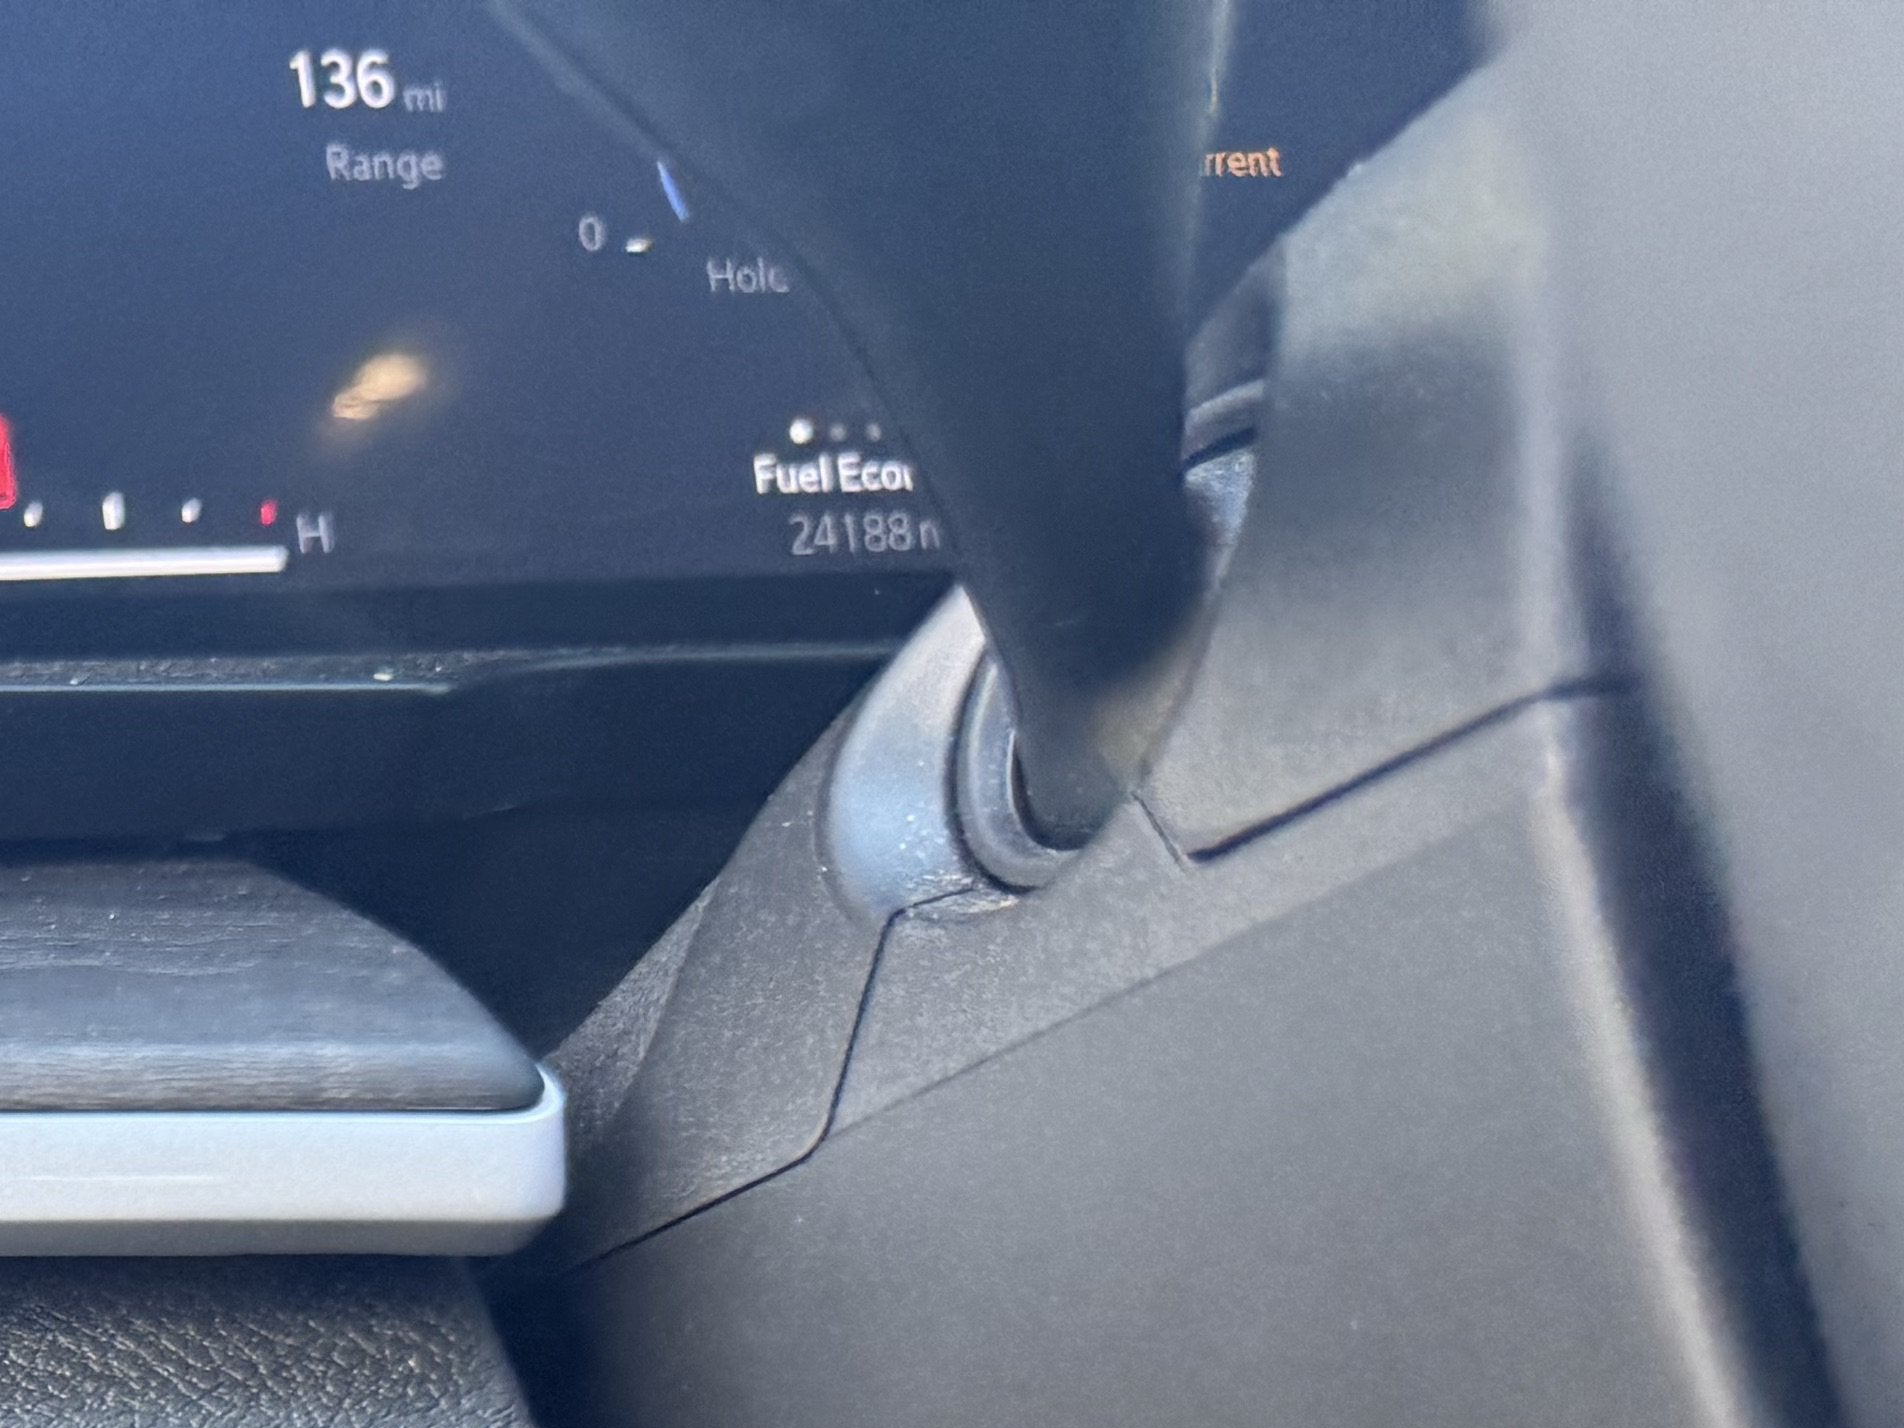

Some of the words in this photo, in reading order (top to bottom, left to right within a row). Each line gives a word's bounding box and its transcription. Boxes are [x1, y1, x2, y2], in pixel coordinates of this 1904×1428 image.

[290, 49, 395, 109] 136
[403, 81, 446, 112] mi
[326, 142, 444, 190] Range
[1200, 147, 1283, 177] rrent
[578, 213, 604, 252] 0
[753, 453, 834, 494] Fuel
[296, 510, 334, 554] H
[790, 510, 913, 556] 24188
